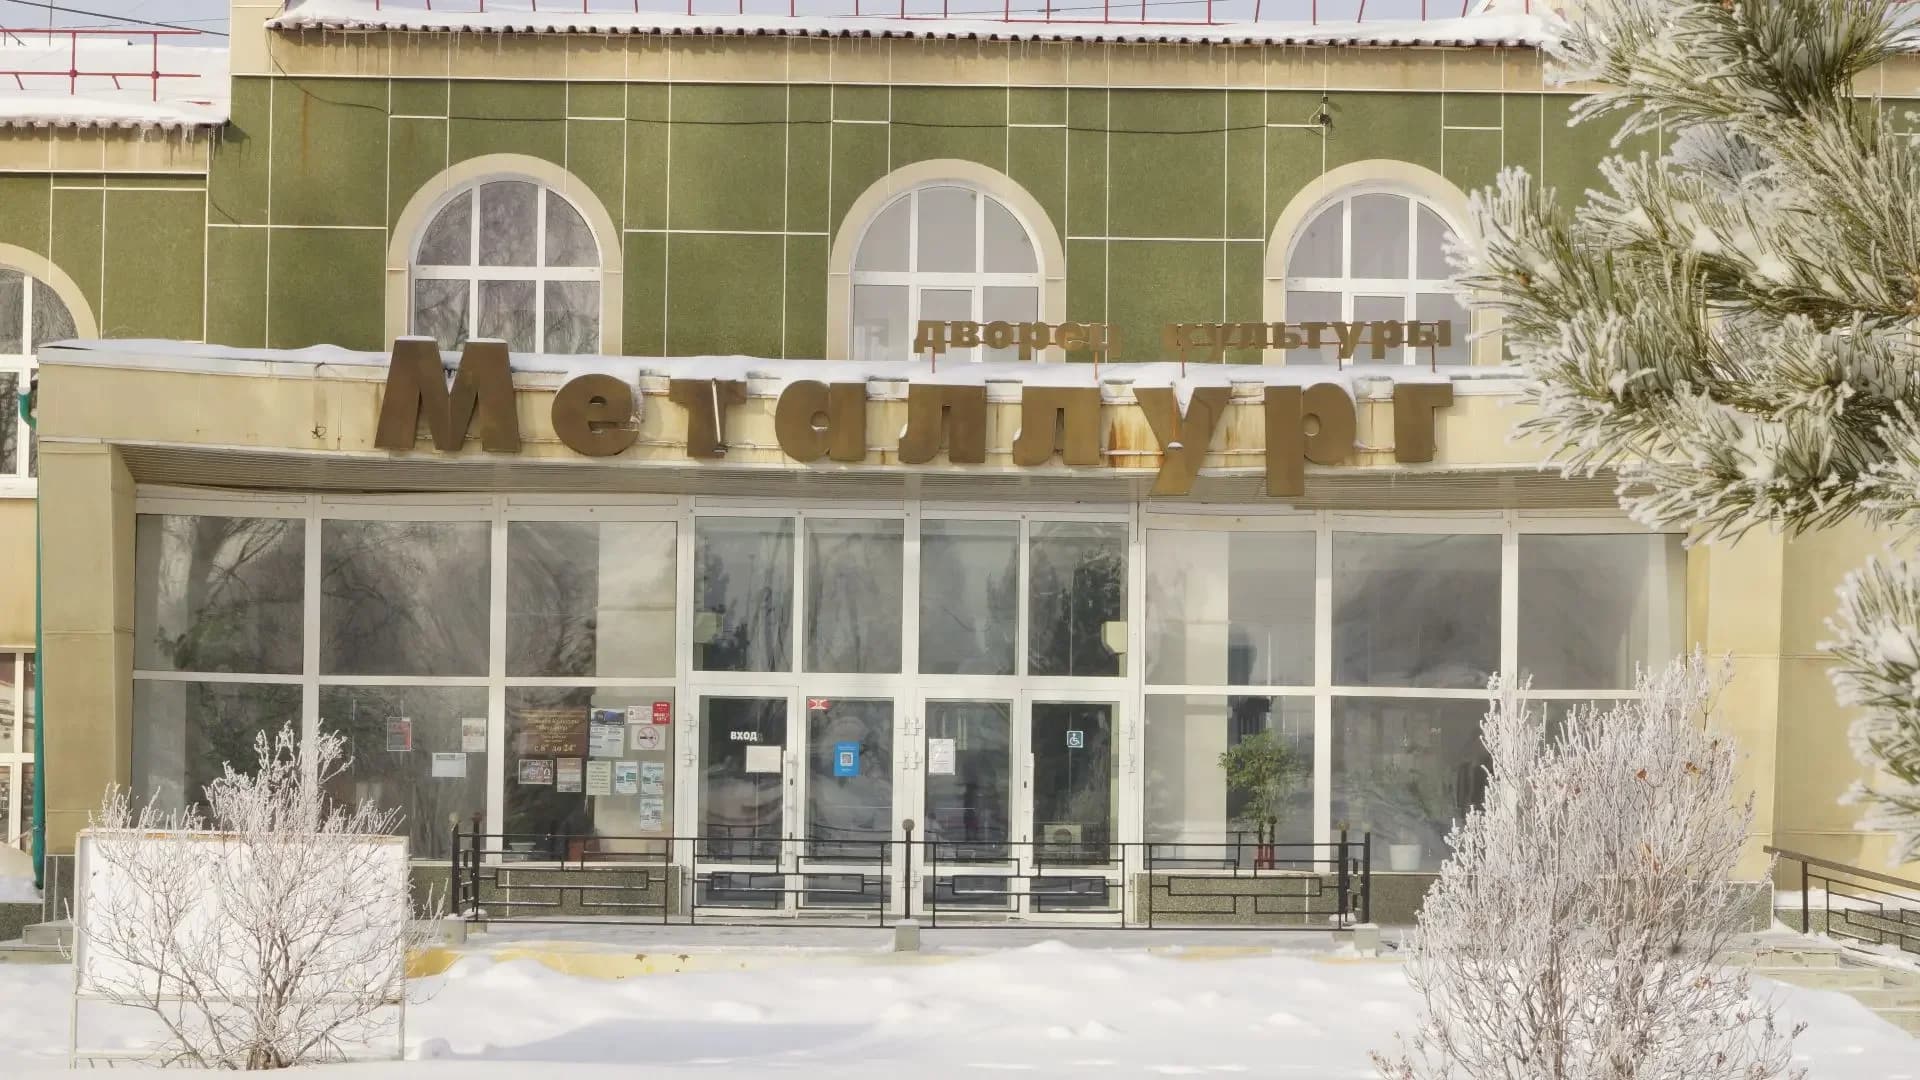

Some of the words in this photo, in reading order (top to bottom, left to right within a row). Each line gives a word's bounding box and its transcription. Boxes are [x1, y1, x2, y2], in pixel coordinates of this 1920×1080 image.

[913, 319, 1122, 361] дворец
[1162, 319, 1452, 359] культуры
[375, 338, 1453, 498] Металлург
[730, 731, 758, 741] ВХОД
